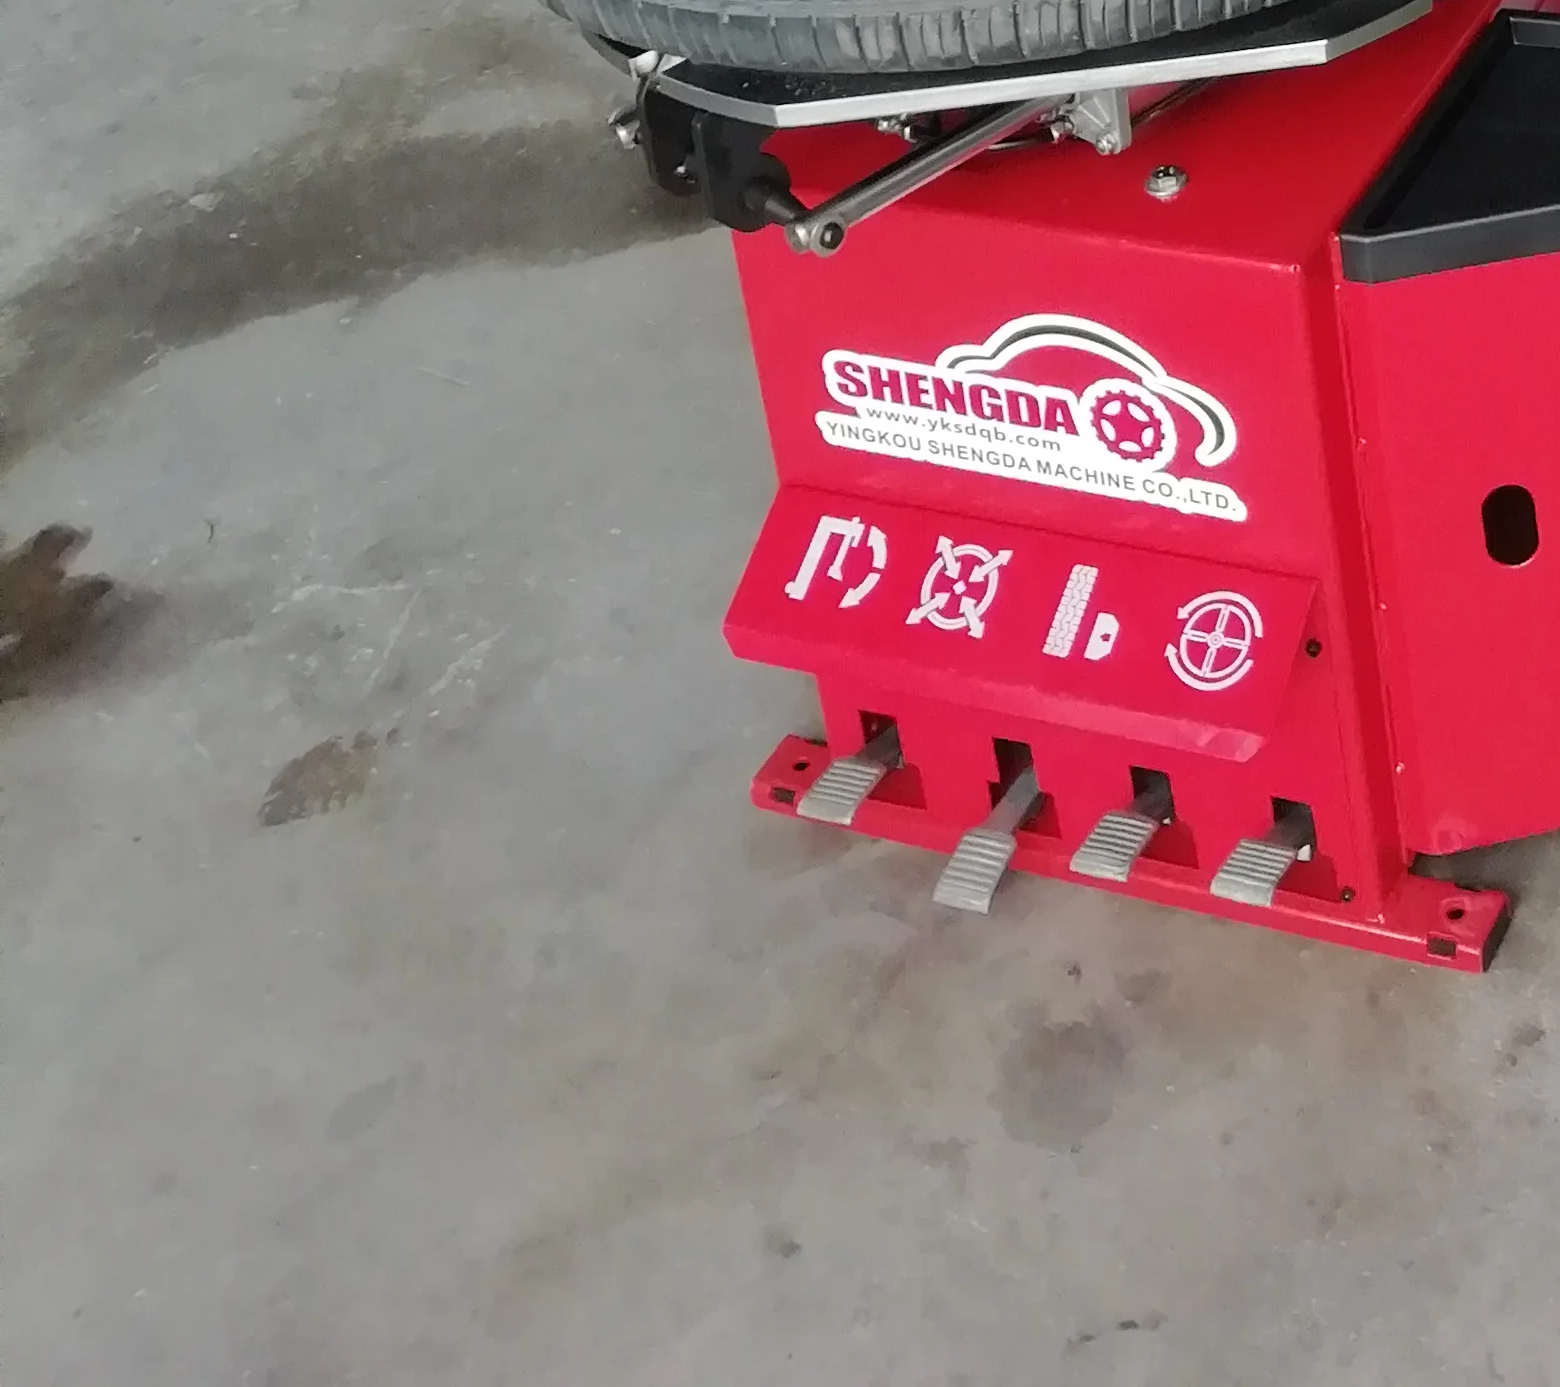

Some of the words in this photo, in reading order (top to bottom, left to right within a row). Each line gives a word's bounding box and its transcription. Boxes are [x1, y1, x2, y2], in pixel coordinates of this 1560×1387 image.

[833, 360, 1080, 436] SHENGDA
[866, 407, 1062, 452] www.yksdqb.com
[826, 421, 921, 452] YINGKOU
[928, 440, 1032, 472] SHENGDA
[1036, 459, 1136, 492] MACHINE
[1142, 478, 1238, 512] CO.,LTD.
